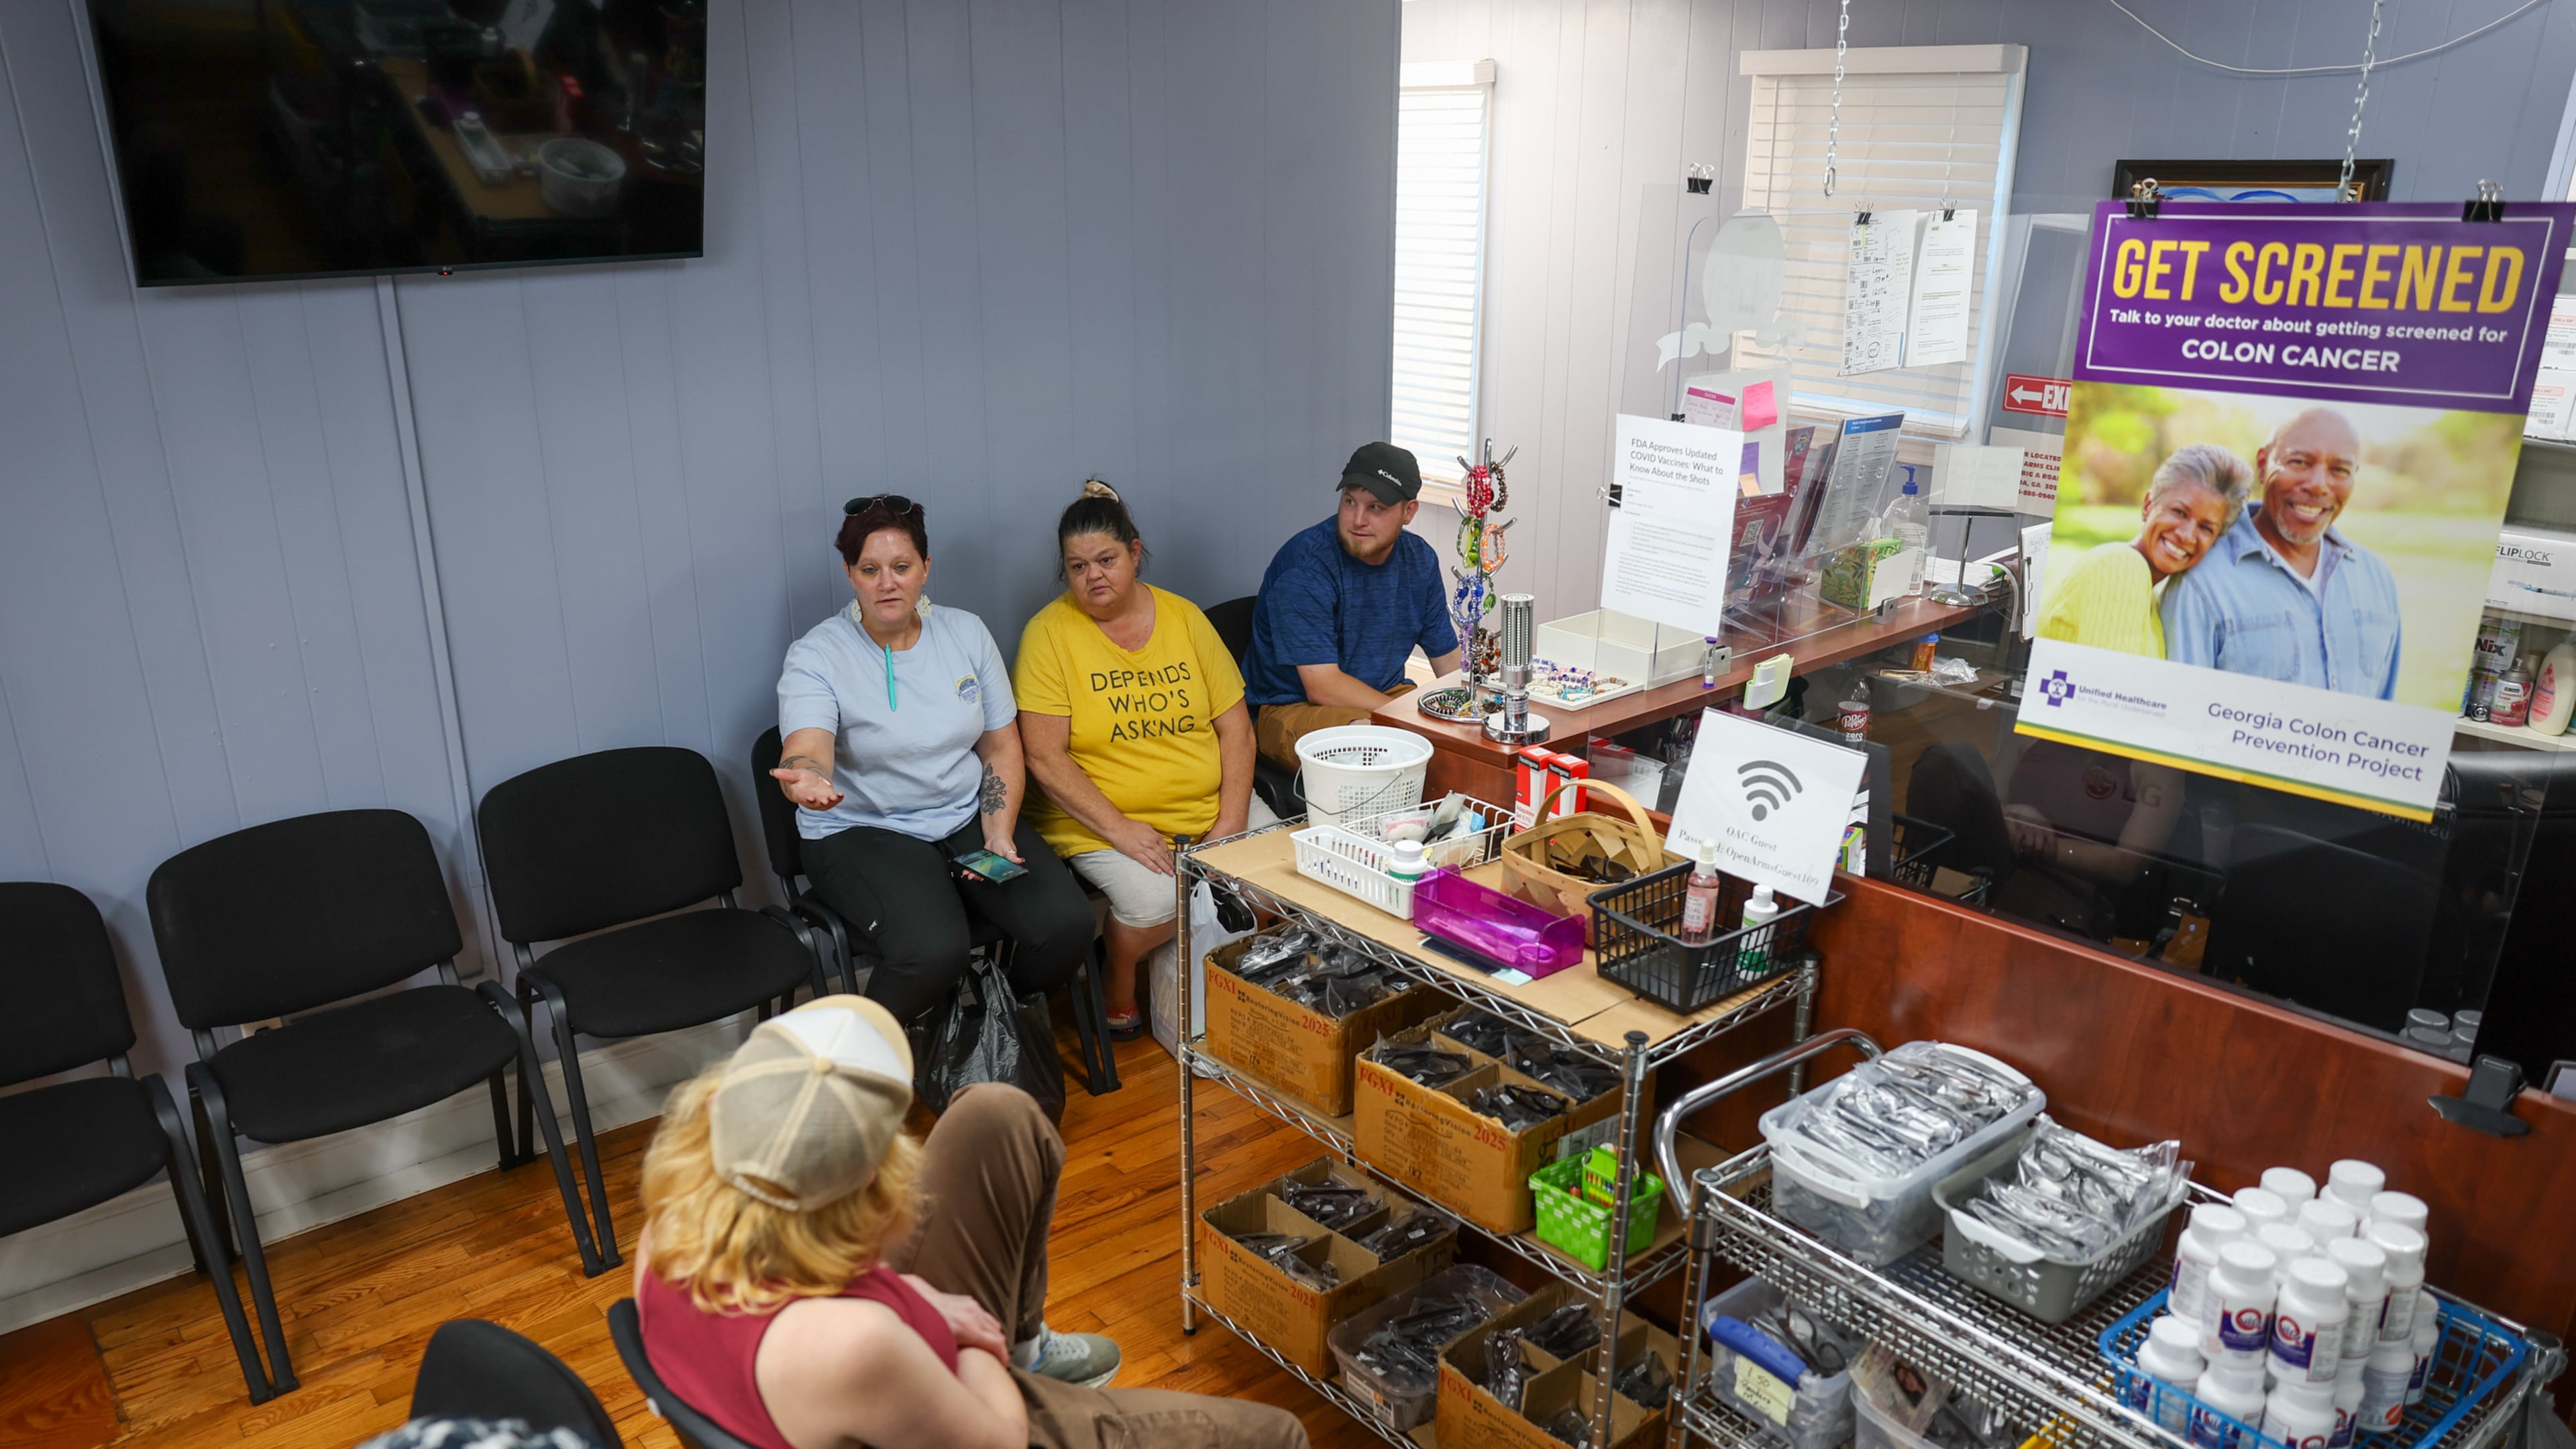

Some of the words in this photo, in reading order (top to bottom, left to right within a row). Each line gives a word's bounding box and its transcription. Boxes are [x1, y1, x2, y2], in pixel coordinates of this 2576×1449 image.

[2112, 238, 2210, 301] GET
[2219, 240, 2525, 314] SCREENED
[2110, 309, 2141, 325] Talk
[2145, 312, 2161, 326] to
[2165, 315, 2200, 331] your
[2205, 314, 2259, 331] doctor
[2263, 317, 2310, 334] about
[2316, 321, 2381, 339] getting
[2386, 323, 2471, 341] screened
[2478, 327, 2507, 343] for
[2182, 339, 2273, 364] COLON
[2282, 345, 2400, 372] CANCER
[2042, 384, 2071, 411] EXI
[1631, 438, 1648, 449] FDA
[1649, 441, 1683, 455] Approves
[1685, 447, 1717, 461] Updated
[2031, 452, 2061, 462] LOCATED
[1629, 464, 1650, 474] Know
[1652, 468, 1674, 480] About
[1676, 472, 1688, 482] the
[1689, 474, 1710, 486] Shots
[1631, 451, 1656, 463] COVID
[1658, 455, 1690, 469] Vaccines:
[1693, 462, 1713, 474] What
[1715, 467, 1723, 475] to
[1383, 471, 1402, 486] Columbia
[2019, 489, 2055, 500] -886-0940
[2475, 637, 2506, 657] Nix
[1091, 661, 1191, 692] DEPENDS
[1108, 689, 1189, 714] WHO'S
[2079, 686, 2112, 699] Unified
[2114, 692, 2167, 710] Healthcare
[1844, 715, 1866, 729] Pepper
[2208, 702, 2283, 732] Georgia
[2289, 718, 2348, 743] Colon
[2353, 731, 2429, 759] Cancer
[2232, 729, 2342, 765] Prevention
[2347, 751, 2422, 782] Project
[1727, 826, 1750, 841] OAC
[1751, 833, 1778, 852] Guest
[1678, 829, 1723, 854] Passd:
[1725, 847, 1819, 886] OpenArmsGuest109
[1686, 906, 1701, 914] CIAL
[1208, 970, 1236, 994] FGXI
[1246, 995, 1301, 1026] RestoringVision
[1302, 1015, 1330, 1037] 2025
[1359, 1066, 1394, 1096] FGXI
[1405, 1099, 1471, 1136] RestoringVision
[1473, 1125, 1507, 1152] 2025
[1203, 1227, 1230, 1255] FGXI
[1291, 1285, 1316, 1309] 2025
